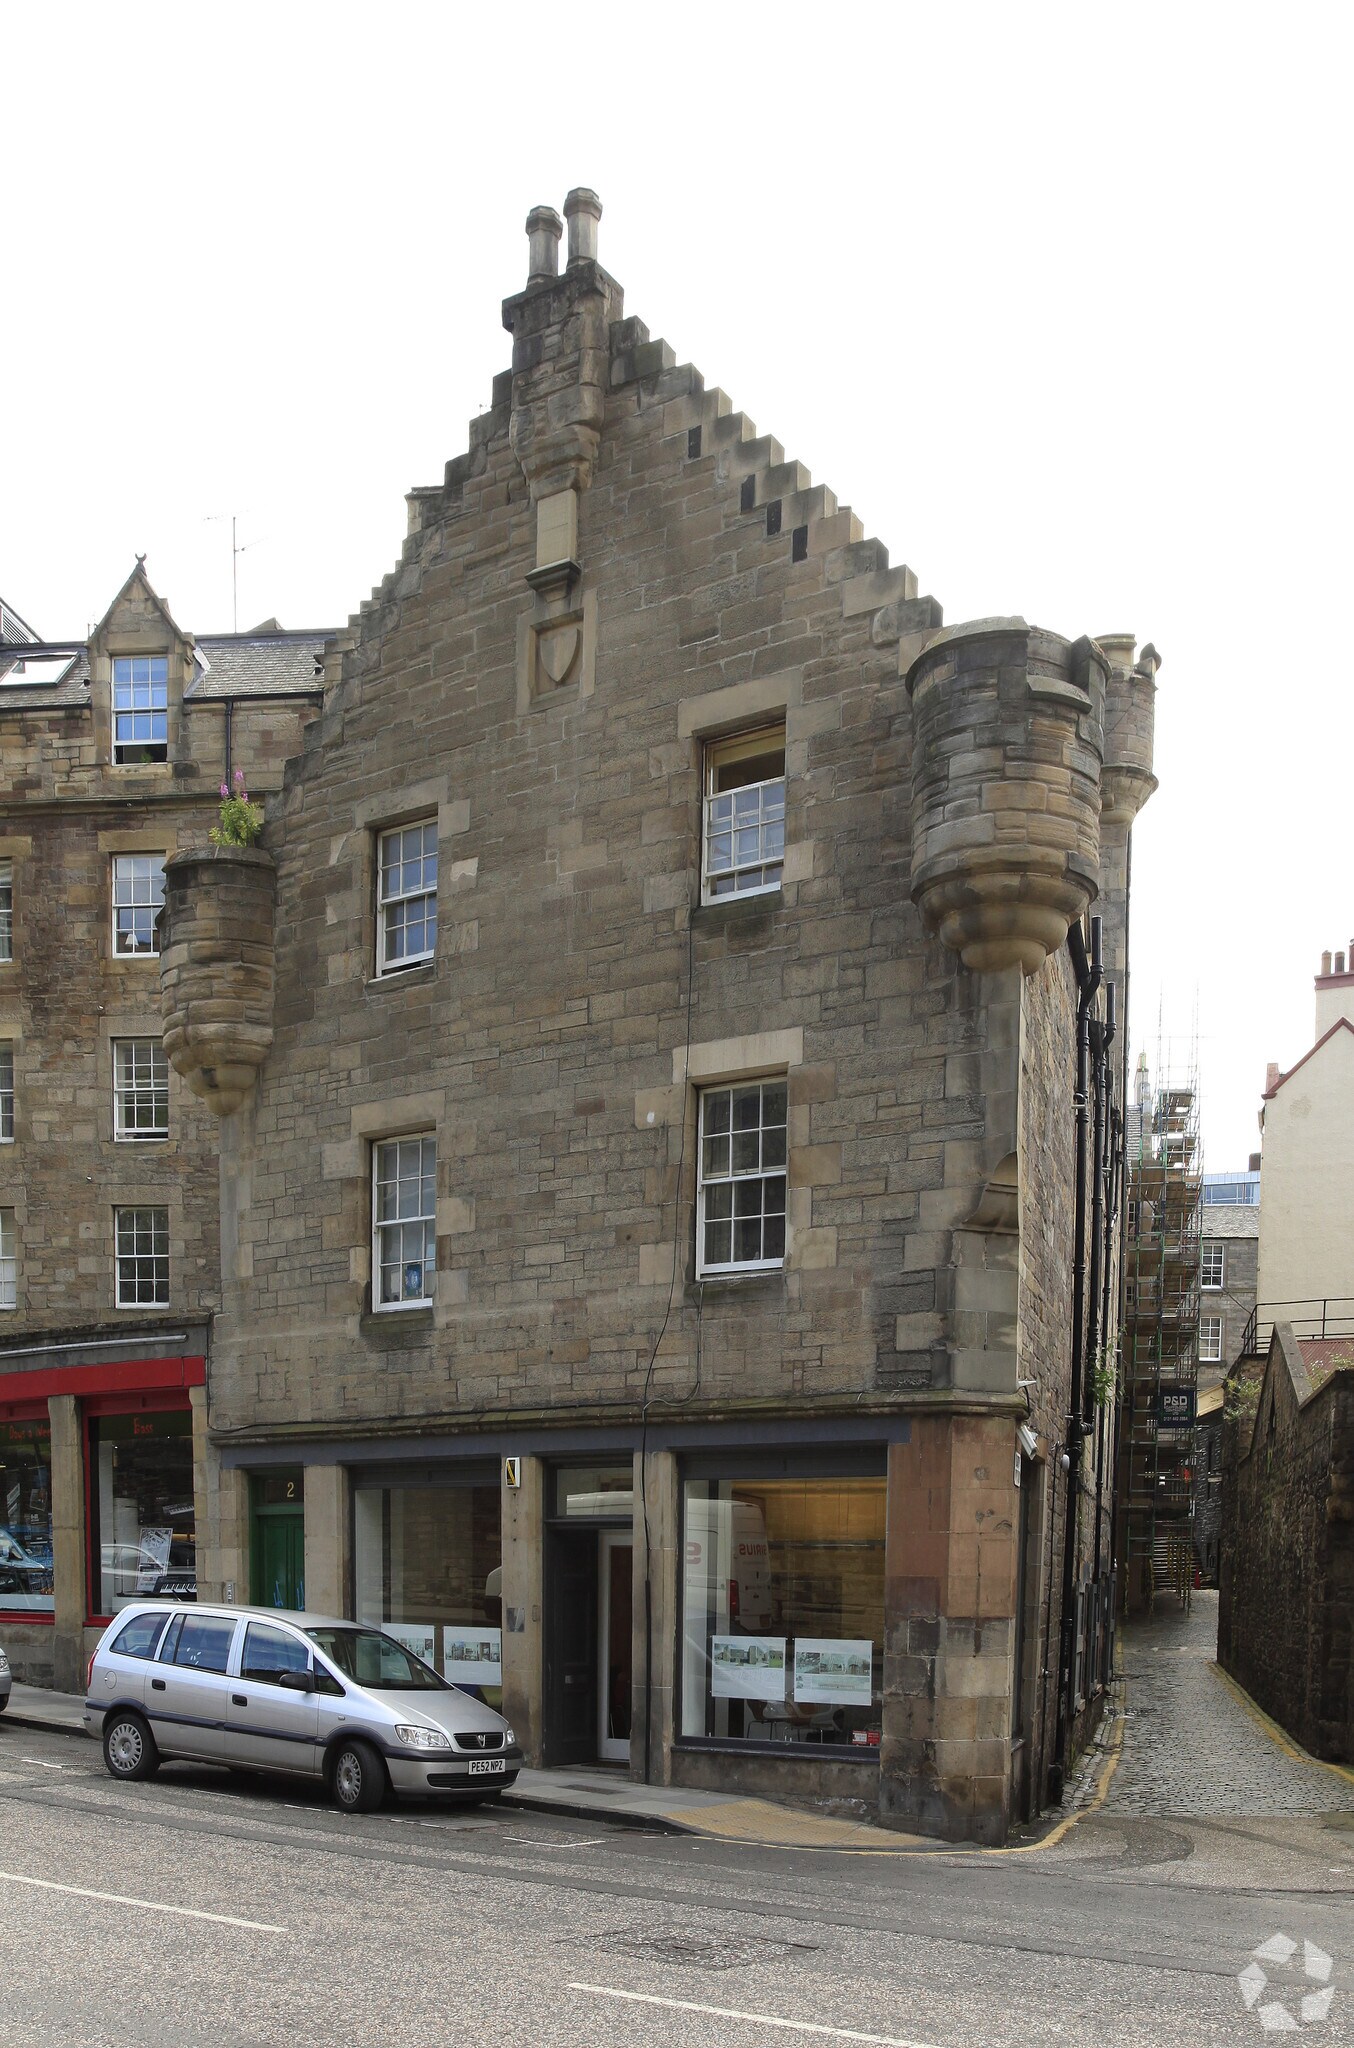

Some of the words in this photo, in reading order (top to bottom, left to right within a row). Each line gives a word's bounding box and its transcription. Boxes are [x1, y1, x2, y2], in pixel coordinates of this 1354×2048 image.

[1163, 1396, 1188, 1406] P&D
[287, 1482, 294, 1497] 2
[472, 1761, 490, 1772] PE52
[491, 1760, 503, 1771] NPZ
